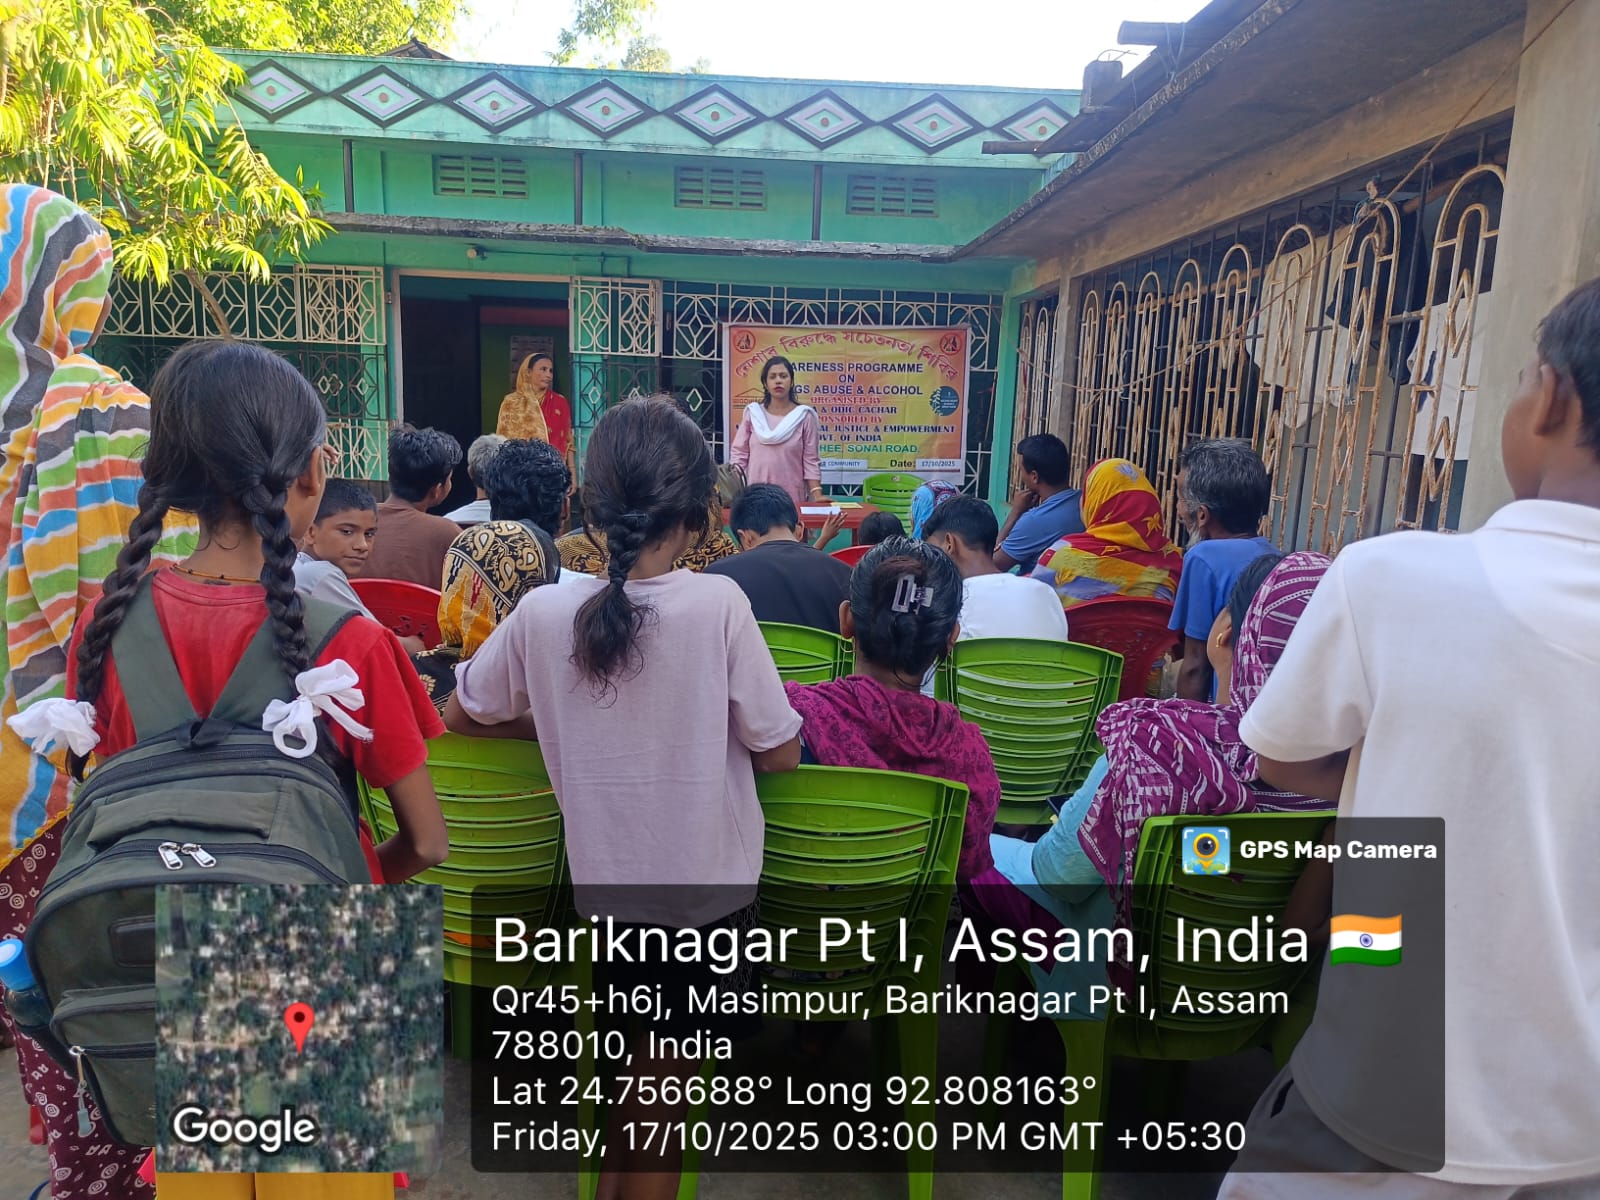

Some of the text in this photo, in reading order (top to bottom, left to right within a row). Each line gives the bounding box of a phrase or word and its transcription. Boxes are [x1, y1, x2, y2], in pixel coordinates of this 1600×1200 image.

[792, 363, 924, 373] ARENESS PROGRAMME
[838, 374, 855, 383] ON
[814, 385, 853, 395] ABUSE
[856, 385, 864, 395] &
[867, 386, 923, 396] ALCOHOL
[810, 396, 866, 404] ORGANISED
[858, 406, 898, 415] CACHAR
[819, 415, 868, 423] ONSORED
[834, 424, 870, 433] JUSTICE
[883, 424, 955, 433] EMPOWERMENT
[840, 434, 851, 442] OF
[855, 434, 883, 442] INDIA
[847, 444, 883, 454] SONAI
